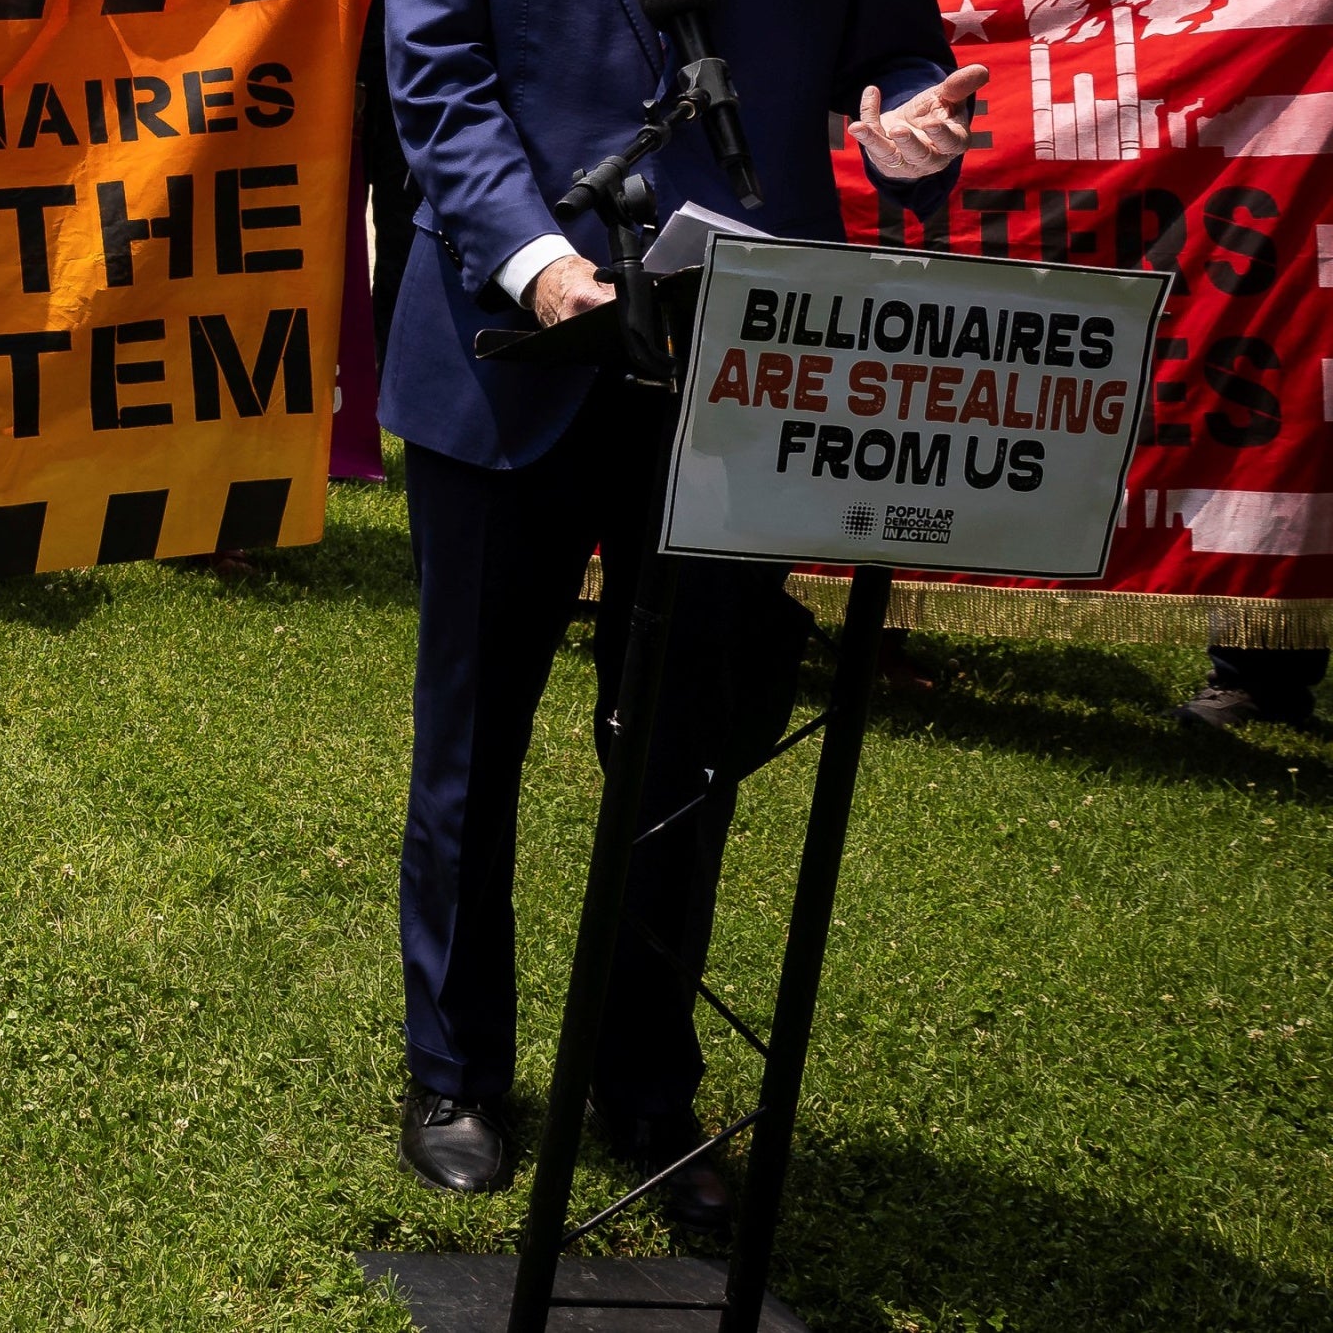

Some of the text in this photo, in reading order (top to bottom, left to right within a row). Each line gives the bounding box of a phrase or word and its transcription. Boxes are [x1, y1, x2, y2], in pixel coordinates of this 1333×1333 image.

[739, 287, 1115, 369] BILLIONAIRES
[707, 347, 835, 413] ARE
[847, 360, 1128, 436] STEALING
[776, 420, 1046, 493] FROM US
[885, 517, 952, 529] DEMOCRACY
[886, 506, 954, 520] POPULAR
[884, 528, 948, 542] IN ACTION
